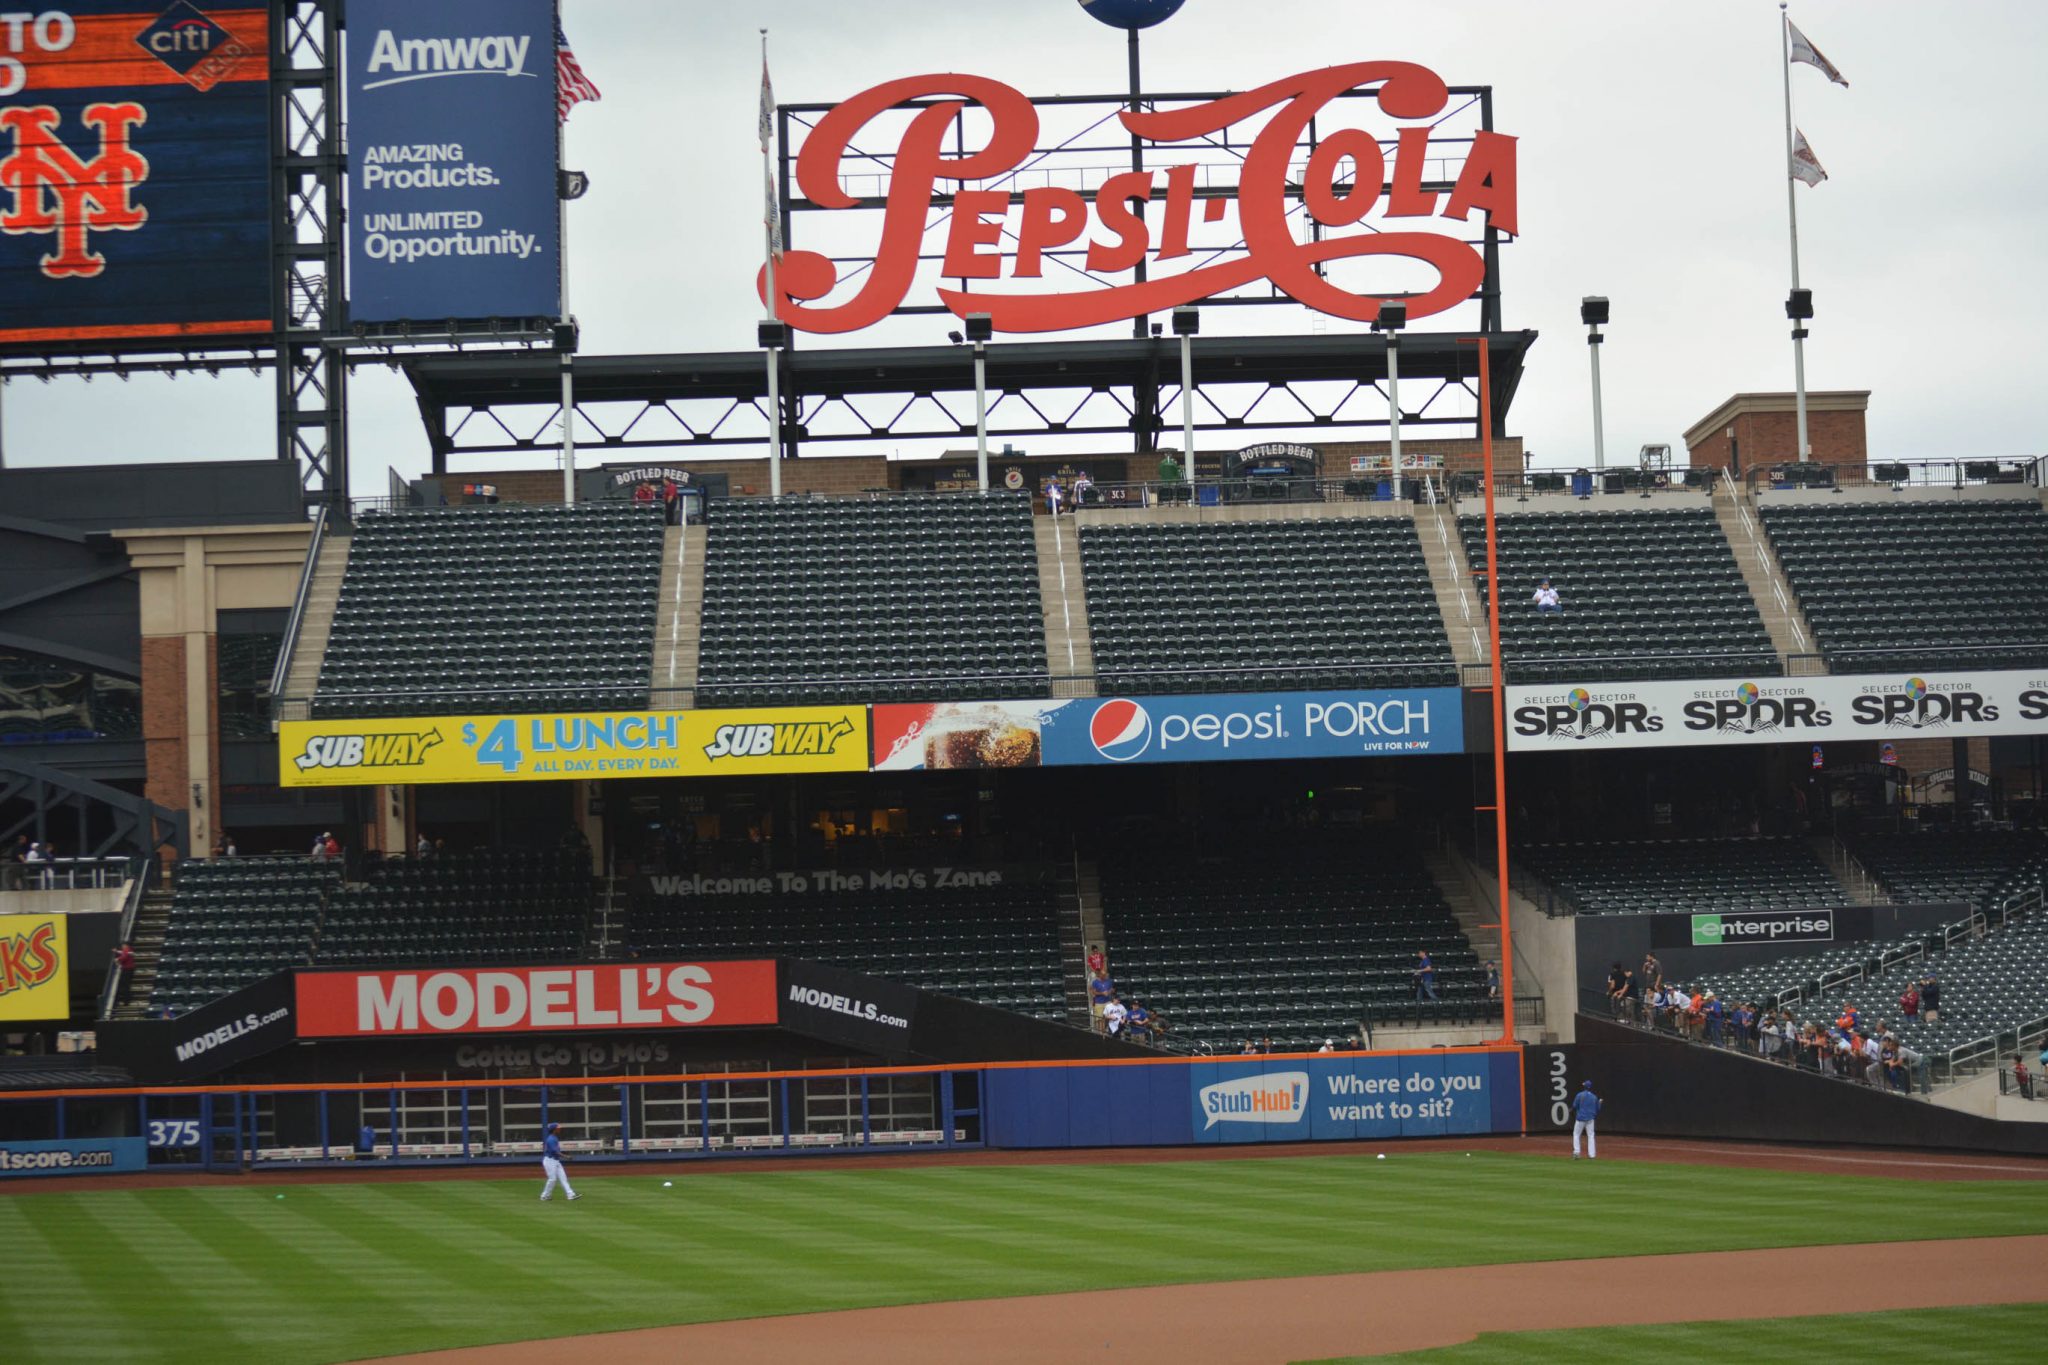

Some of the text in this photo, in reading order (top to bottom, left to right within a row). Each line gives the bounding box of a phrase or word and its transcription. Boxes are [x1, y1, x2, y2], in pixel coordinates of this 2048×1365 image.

[0, 11, 76, 52] TO
[150, 25, 210, 52] citi
[367, 30, 531, 77] Amway
[363, 143, 464, 164] AMAZING
[363, 162, 501, 189] Products.
[363, 210, 484, 232] UNLIMITED
[363, 228, 543, 263] Opportunity.
[1239, 444, 1314, 461] BOTTLED BEER
[615, 467, 690, 486] BOTTLED BEER
[1524, 693, 1637, 705] SELECT SECTOR
[1693, 687, 1806, 699] SELECT SECTOR
[1862, 682, 1973, 693] SELECT SECTOR
[1513, 702, 1665, 737] SPDRs
[1683, 696, 1833, 731] SPDRs
[1851, 691, 2000, 726] SPDRs
[1160, 700, 1430, 750] pepsi PORCH
[293, 726, 444, 774] SUBWAY
[461, 715, 679, 773] $4 LUNCH
[703, 716, 855, 763] SUBWAY
[1364, 742, 1383, 751] LIVE
[1385, 741, 1403, 750] FOR
[533, 756, 680, 772] ALL DAY. EVERY DAY.
[651, 867, 1001, 895] Welcome To The Mo's Zone
[1700, 917, 1830, 938] enterprise
[0, 922, 59, 996] KS
[357, 965, 715, 1031] MODELL'S
[789, 984, 908, 1028] MODELLS.com
[176, 1006, 288, 1062] MODELLS.com
[456, 1040, 669, 1068] Gotta Go To Mo's
[1208, 1081, 1302, 1114] StubHub!
[1327, 1072, 1481, 1096] Where do you
[1328, 1099, 1454, 1120] want to sit?
[149, 1120, 200, 1146] 375
